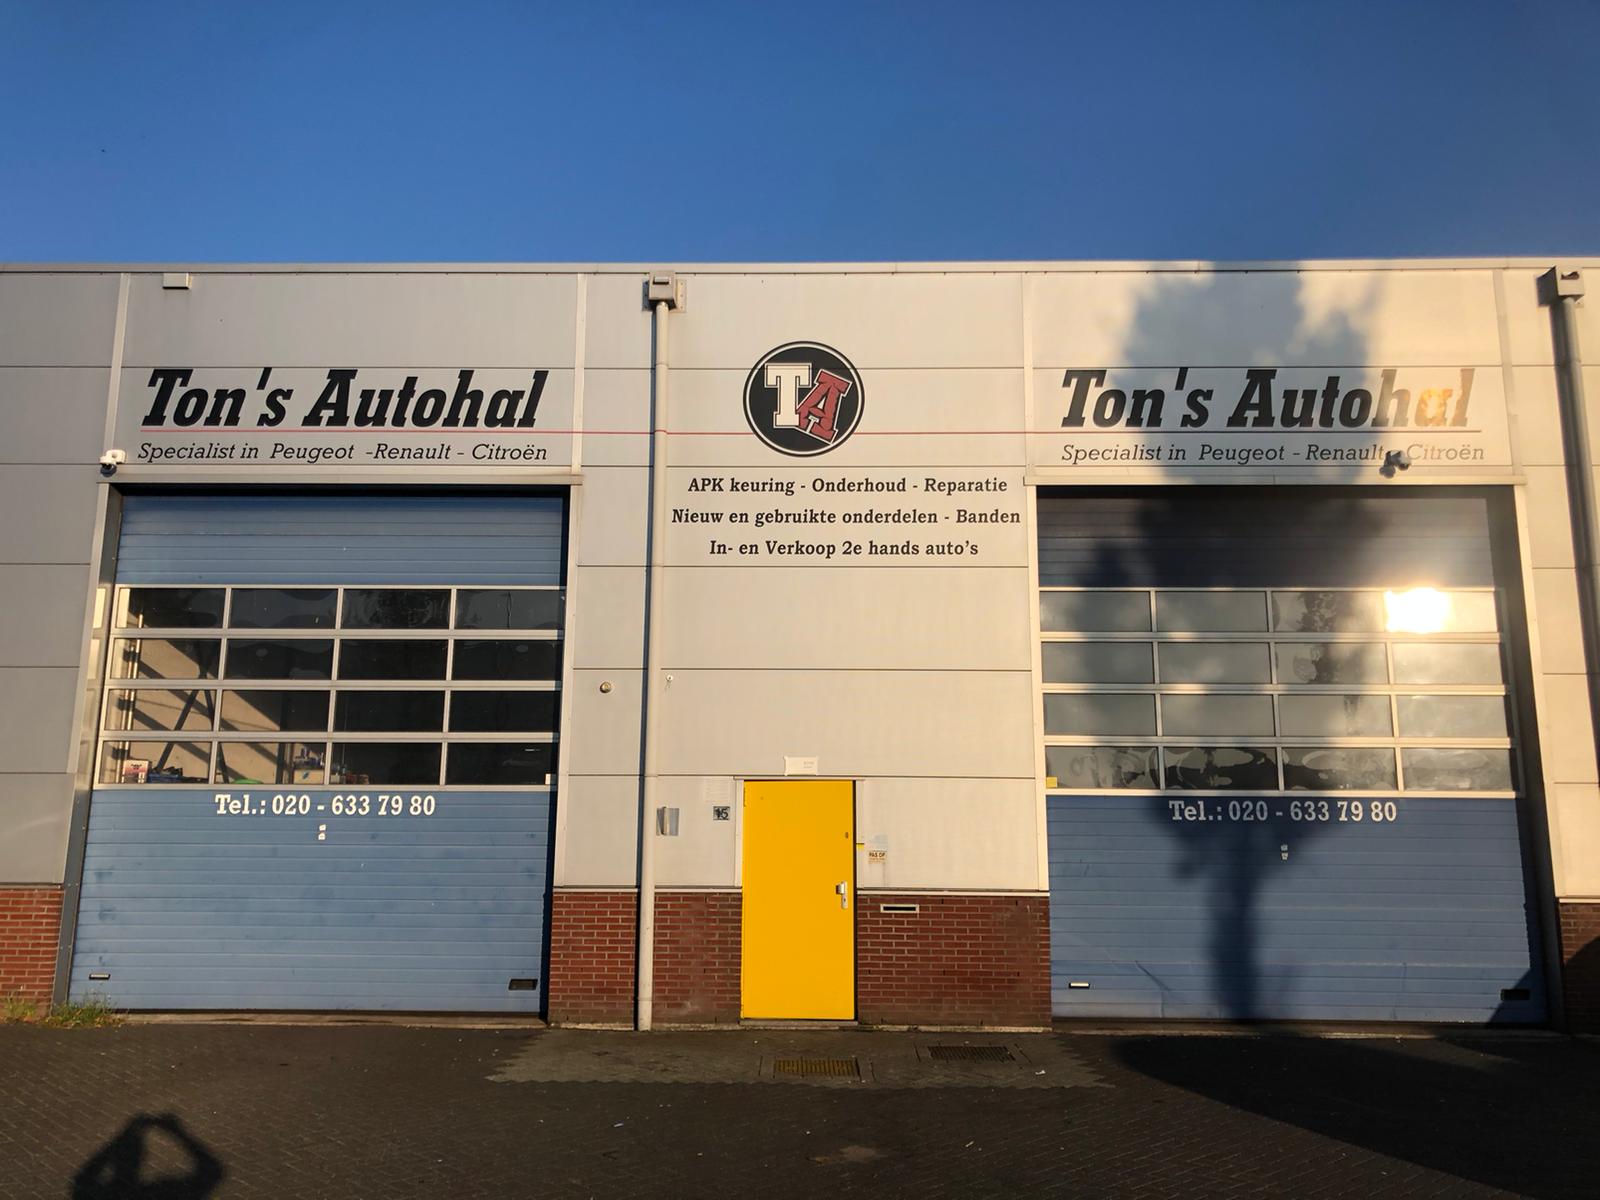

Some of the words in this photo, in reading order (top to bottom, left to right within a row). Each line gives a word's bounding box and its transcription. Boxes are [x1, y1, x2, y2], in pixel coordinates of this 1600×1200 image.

[141, 367, 294, 428] Ton's
[301, 369, 549, 428] Autohal
[1060, 367, 1214, 428] Ton's
[1226, 368, 1476, 428] Autohal
[137, 442, 236, 462] Specialist
[240, 443, 259, 460] in
[269, 443, 355, 464] Peugeot
[471, 443, 547, 461] Citroën
[1061, 444, 1163, 465] Specialist
[1167, 445, 1187, 461] in
[1198, 444, 1286, 464] Peugeot
[1305, 445, 1384, 461] Renault
[1406, 443, 1484, 461] Citroën
[688, 478, 725, 492] APK
[730, 478, 795, 496] keuring
[811, 478, 907, 493] Onderhoud
[923, 478, 1008, 496] Reparatie
[671, 509, 723, 524] Nieuw
[729, 512, 749, 524] en
[754, 509, 837, 527] gebruikte
[842, 509, 938, 524] onderdelen
[955, 509, 1021, 524] Banden
[709, 540, 733, 555] In-
[739, 544, 759, 555] en
[765, 540, 836, 559] Verkoop
[841, 540, 862, 555] 2e
[868, 540, 919, 555] hands
[214, 794, 266, 815] Tel.:
[271, 794, 311, 815] 020
[331, 795, 370, 815] 633
[378, 795, 403, 816] 79
[409, 795, 436, 816] 80
[1168, 800, 1223, 821] Tel.:
[1228, 800, 1268, 821] 020
[1289, 801, 1330, 821] 633
[1337, 801, 1363, 822] 79
[1370, 801, 1397, 822] 80
